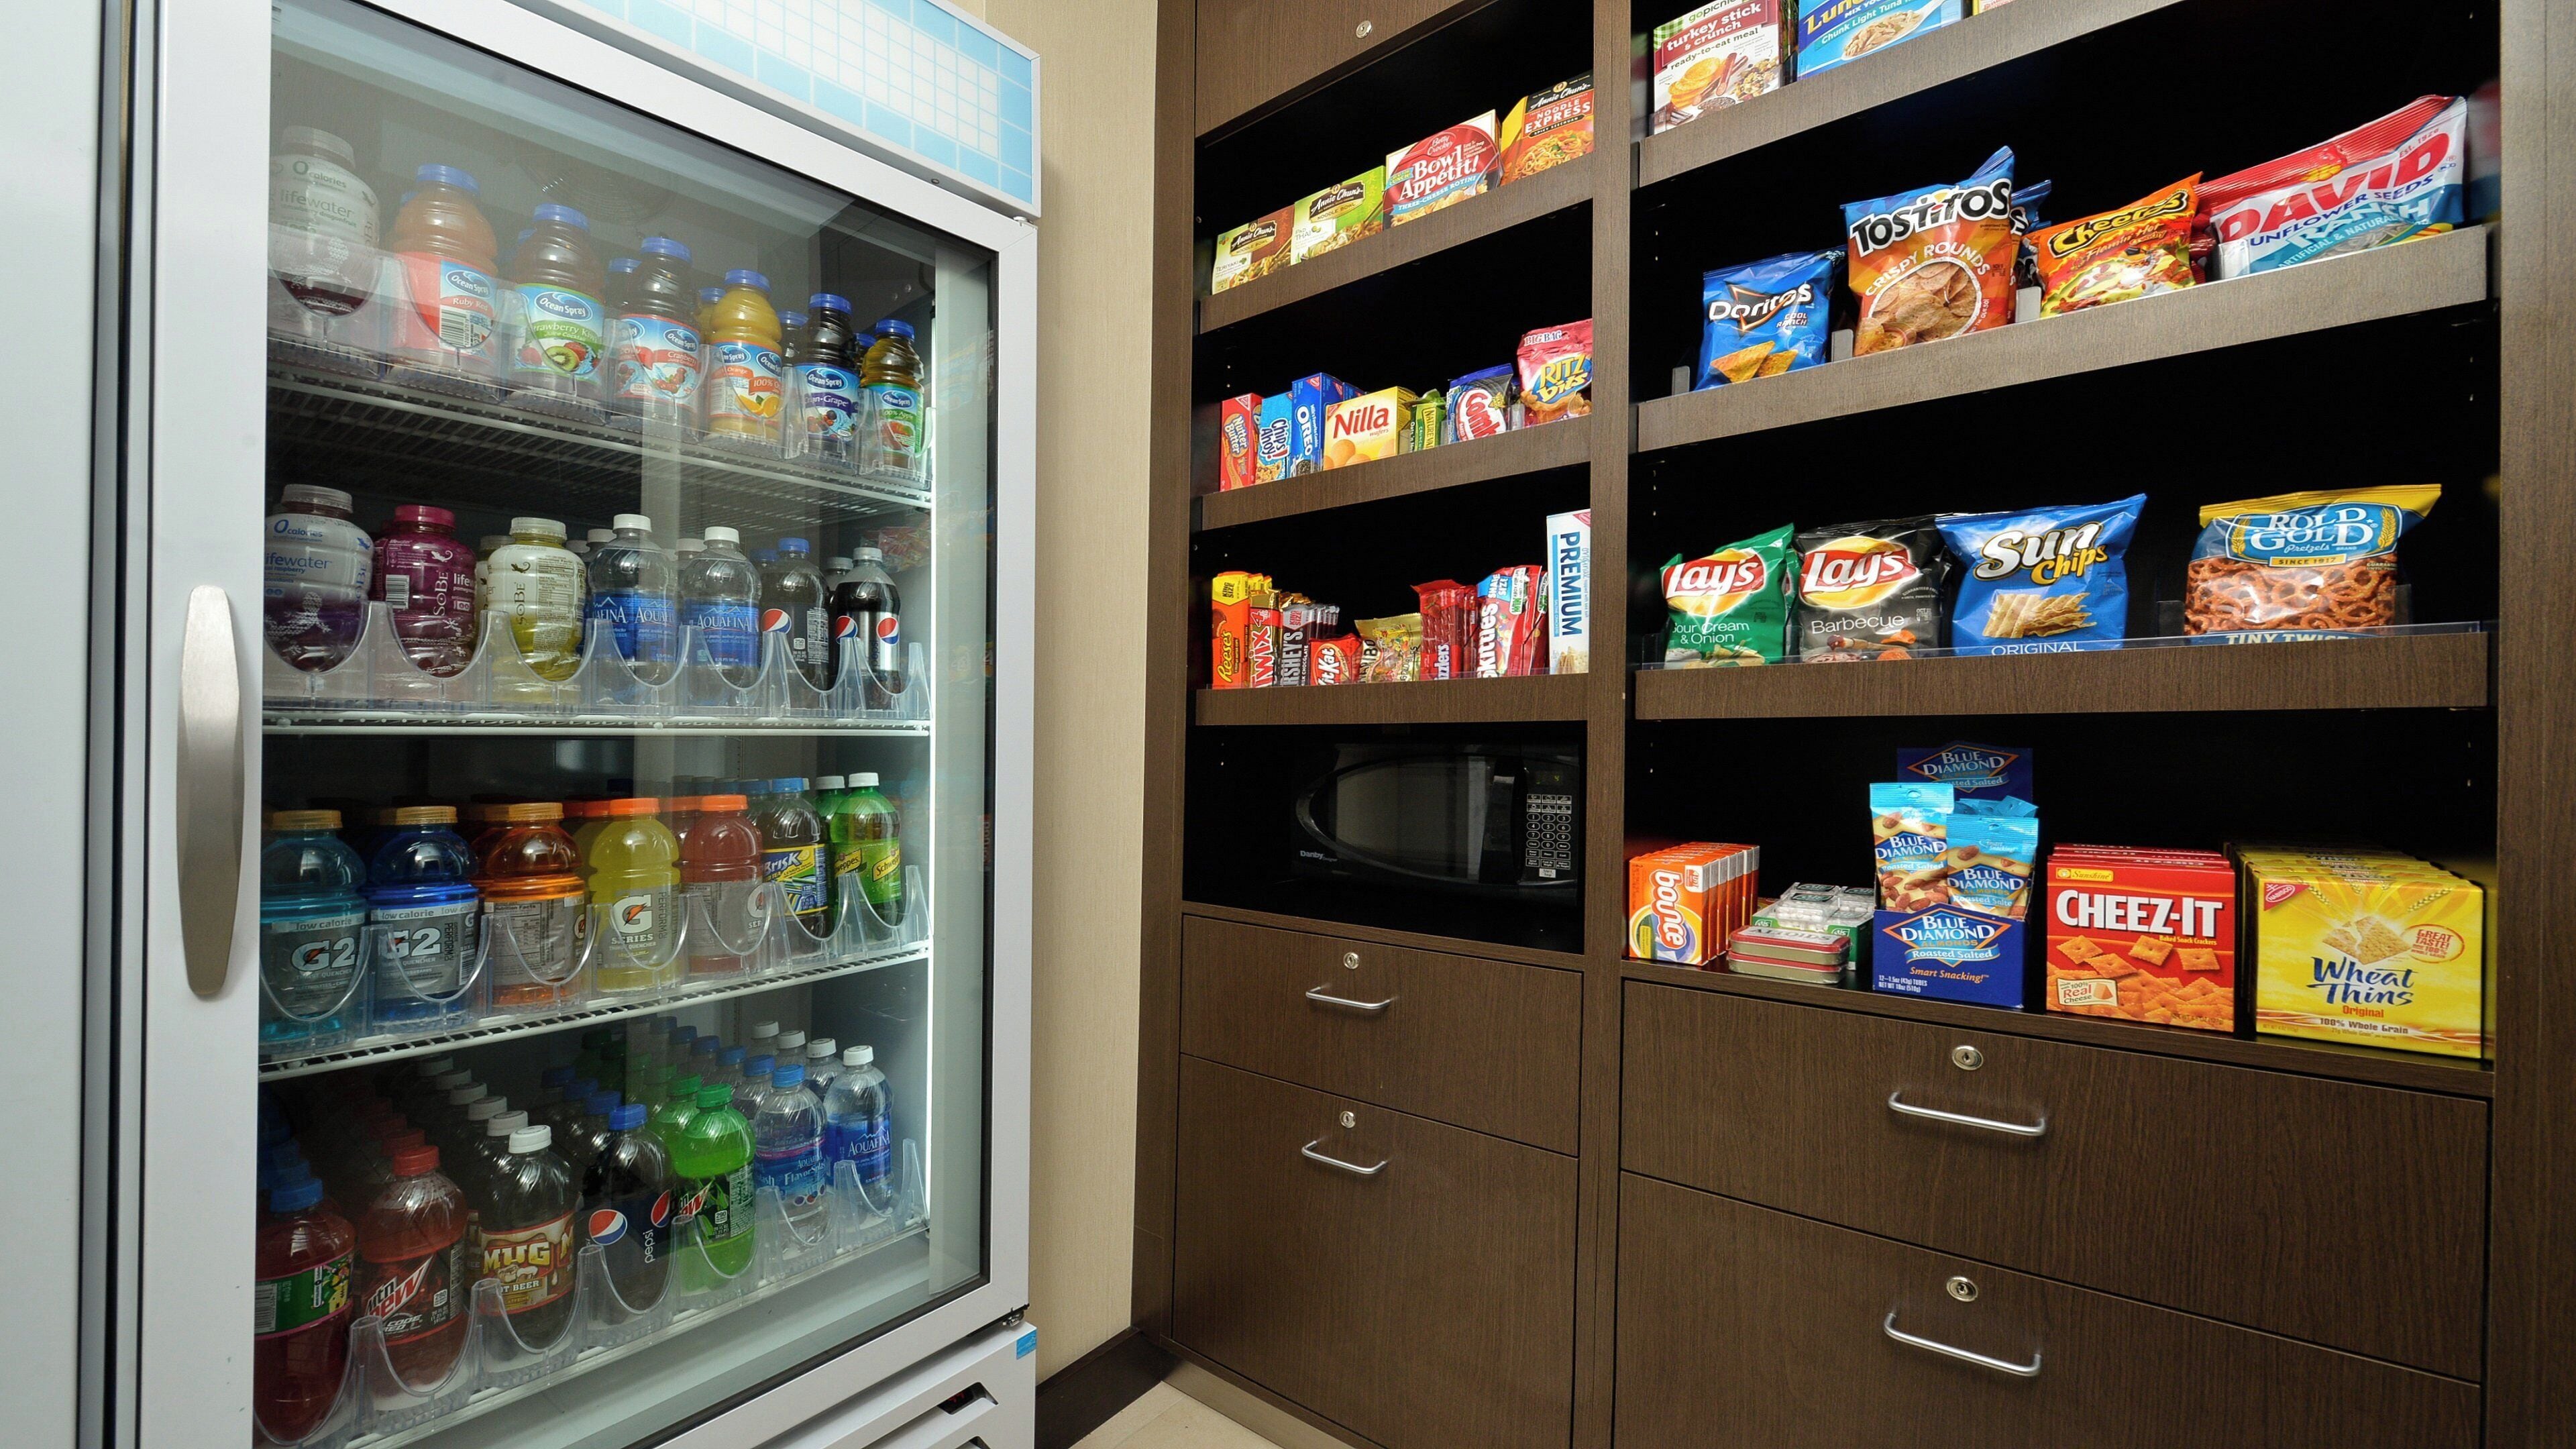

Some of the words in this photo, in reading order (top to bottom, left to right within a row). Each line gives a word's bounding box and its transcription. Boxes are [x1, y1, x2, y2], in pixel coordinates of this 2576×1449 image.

[1845, 6, 1862, 19] MIX
[1667, 19, 1717, 51] turkey
[1721, 3, 1762, 25] stick
[1821, 25, 1850, 44] Chunk
[1852, 9, 1877, 27] Light
[1879, 0, 1902, 13] Tuna
[1684, 43, 1691, 51] &
[1694, 21, 1741, 46] crunch
[1671, 38, 1731, 70] ready-to-eat
[1733, 28, 1758, 43] meal
[1530, 94, 1559, 111] Annie
[1560, 82, 1591, 99] Chun's
[1536, 97, 1580, 121] NOODLE
[1524, 101, 1591, 135] EXPRESS
[1432, 133, 1450, 148] Betty
[2400, 144, 2415, 159] Est.
[1412, 144, 1464, 182] Bowl
[309, 172, 347, 188] calories
[1449, 174, 1477, 191] ROTINI
[2219, 131, 2451, 242] DAVID
[280, 189, 354, 219] lifewater
[1310, 195, 1336, 214] Annie
[1336, 187, 1363, 201] Chun's
[1317, 208, 1340, 220] NOODLE
[1340, 202, 1356, 213] BOWL
[2249, 193, 2368, 247] UNFLOWER
[2374, 174, 2434, 200] SEEDS
[2048, 189, 2189, 258] Cheetos
[2135, 222, 2165, 237] Hot
[1231, 231, 1253, 250] Annie
[2277, 240, 2332, 268] ARTIFICIAL
[2334, 231, 2345, 242] &
[2347, 214, 2397, 235] NATURAL
[1865, 251, 1919, 297] CRISPY
[1924, 241, 1990, 275] ROUNDS
[451, 275, 474, 290] Ocean
[453, 298, 474, 307] Ruby
[539, 297, 565, 313] Ocean
[564, 305, 586, 318] Spray
[1709, 282, 1813, 321] Doritos
[1776, 319, 1808, 328] RANCH
[667, 333, 684, 346] Ocean
[1523, 334, 1542, 346] BIG
[1542, 330, 1562, 343] BAG
[729, 353, 745, 363] Spray
[760, 356, 776, 370] Ocean
[1540, 352, 1587, 388] RITZ
[753, 378, 773, 388] 100%
[808, 374, 826, 385] Ocean
[825, 378, 843, 388] Spray
[1536, 371, 1589, 403] bits
[883, 394, 898, 404] Ocean
[897, 397, 911, 406] Spray
[1295, 405, 1313, 456] OREO
[1333, 405, 1389, 439] Nilla
[1424, 409, 1436, 437] NATURE
[1223, 424, 1240, 453] Butter
[1236, 415, 1249, 447] Nutter
[1271, 418, 1288, 450] Chips
[1369, 427, 1389, 437] wafers
[2267, 507, 2368, 531] ROLD
[273, 519, 290, 534] 0
[287, 527, 323, 538] calories
[2250, 522, 2374, 551] GOLD
[1974, 521, 2104, 581] Sun
[2284, 543, 2330, 554] Pretzels
[1665, 558, 1760, 599] Lay's
[1802, 551, 1904, 593] Lay's
[1222, 583, 1230, 598] KING
[1228, 582, 1236, 598] SIZE
[1499, 578, 1509, 596] SIZE
[1560, 531, 1583, 637] PREMIUM
[1511, 597, 1521, 613] WIN
[696, 614, 752, 633] AQUAFINA
[1288, 610, 1296, 626] KING
[1294, 610, 1302, 626] SIZE
[1811, 614, 1904, 635] Barbecue
[1701, 622, 1750, 633] Cream
[1680, 634, 1689, 645] &
[1690, 633, 1735, 645] Onion
[2225, 634, 2278, 645] TINY
[1216, 629, 1234, 684] Reese's
[1991, 641, 2084, 655] ORIGINAL
[1301, 645, 1309, 676] CHOCOLATE
[1923, 756, 2006, 776] DIAMOND
[1941, 751, 1982, 764] BLUE
[1972, 777, 2003, 786] Salted
[1874, 841, 1947, 859] DIAMOND
[1888, 835, 1927, 849] BLUE
[1300, 850, 1324, 861] Danby
[1916, 861, 1945, 871] Salted
[1963, 868, 2003, 881] BLUE
[2072, 869, 2110, 880] Sunshine
[1947, 877, 2025, 891] DIAMOND
[2267, 885, 2294, 902] NABISCO
[382, 910, 400, 920] low
[402, 908, 435, 919] calorie
[612, 894, 653, 934] G
[657, 891, 668, 931] PERFORM
[1654, 871, 1684, 947] bounce
[2055, 889, 2224, 938] CHEEZ-IT
[296, 922, 318, 931] low
[319, 917, 352, 929] calorie
[1922, 915, 1970, 930] BLUE
[444, 922, 454, 955] PERFORM
[1900, 924, 1996, 942] DIAMOND
[2417, 929, 2454, 941] GREAT
[1922, 939, 1979, 947] ALMONDS
[2194, 938, 2218, 946] Crackers
[2415, 936, 2450, 949] TASTE!
[291, 936, 355, 973] G2
[1912, 950, 1955, 959] Roasted
[1957, 950, 1994, 959] Salted
[1910, 967, 1938, 977] Smart
[2310, 956, 2419, 988] Wheat
[1913, 979, 1928, 987] TUBES
[2063, 984, 2092, 999] Real
[2070, 981, 2089, 989] 100%
[2063, 994, 2092, 1004] Cheese
[2306, 982, 2414, 1007] Thins
[2342, 1005, 2385, 1019] Original
[2320, 1017, 2345, 1028] 100%
[2348, 1020, 2379, 1031] Whole
[2381, 1023, 2409, 1034] Grain
[847, 1132, 891, 1157] AQUAFINA
[643, 1228, 656, 1264] pepsi
[482, 1240, 551, 1275] MUG
[513, 1279, 540, 1292] BEER
[387, 1314, 423, 1327] CODE
